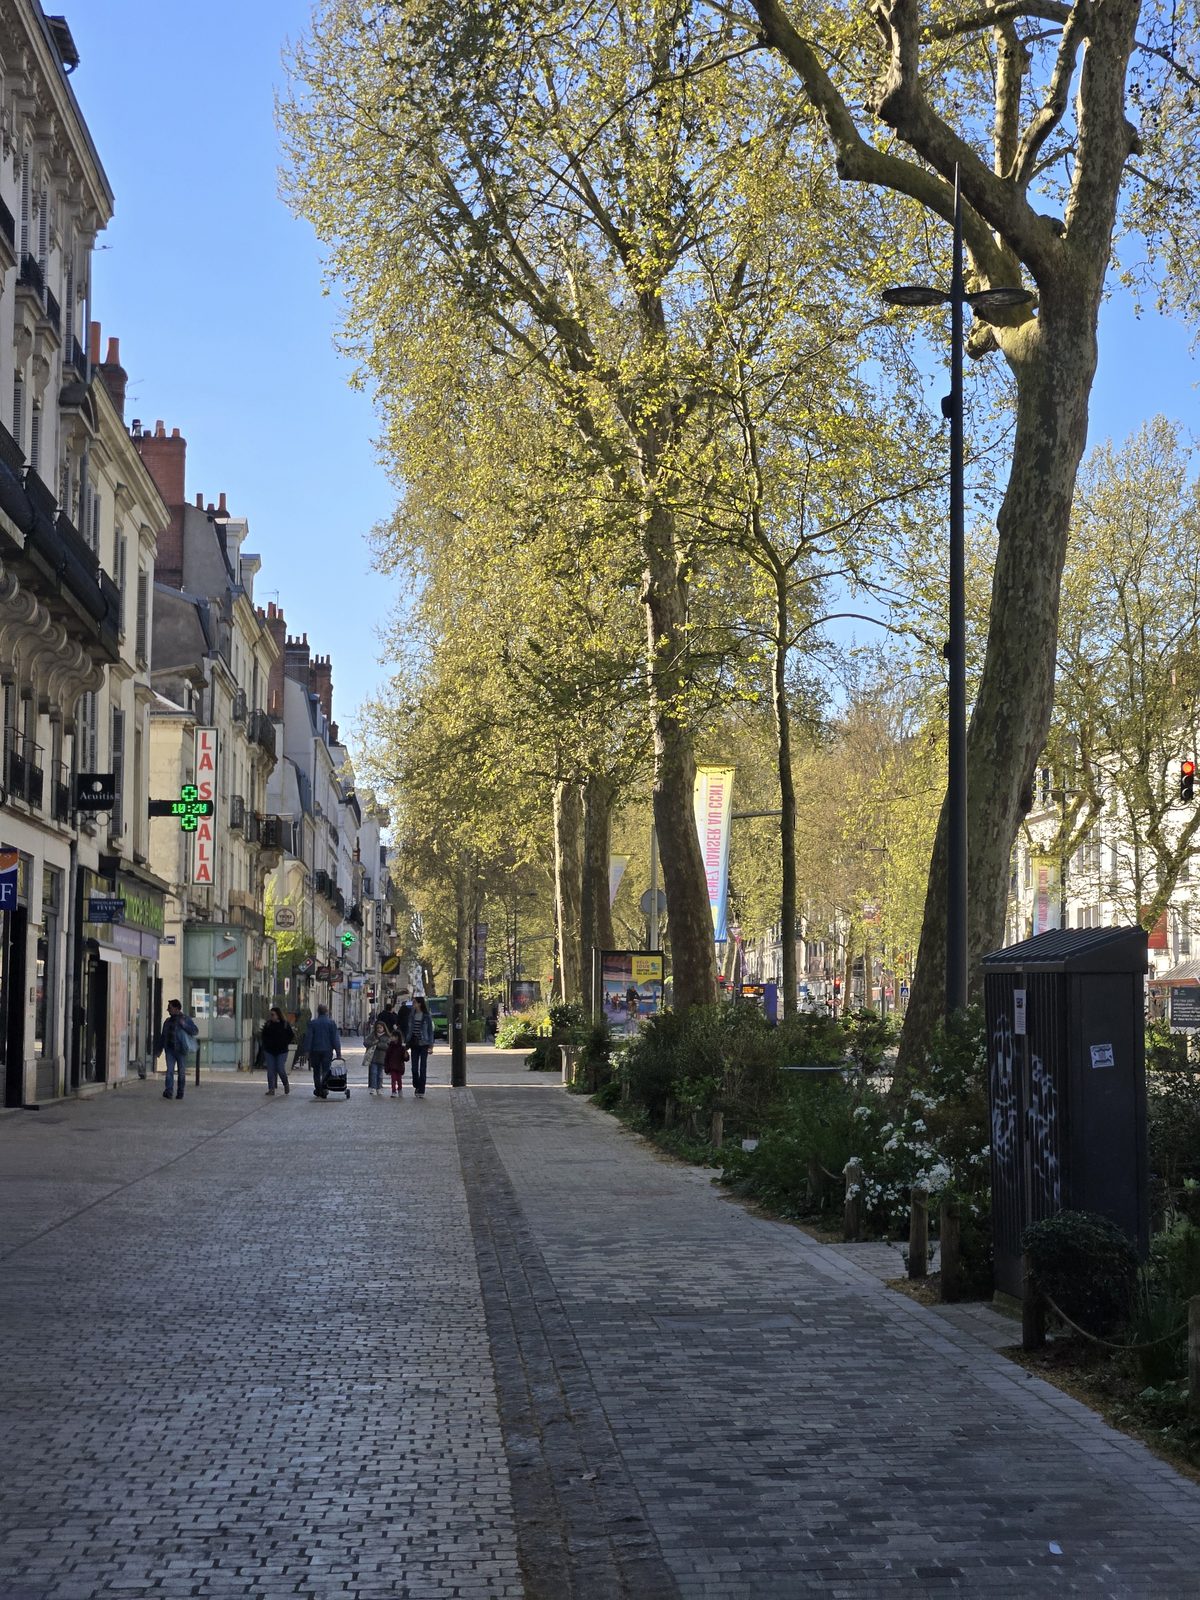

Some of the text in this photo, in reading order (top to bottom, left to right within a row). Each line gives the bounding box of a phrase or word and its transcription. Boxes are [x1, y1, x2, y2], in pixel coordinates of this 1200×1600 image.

[79, 791, 115, 801] Acuitis
[196, 732, 213, 881] LA SALA
